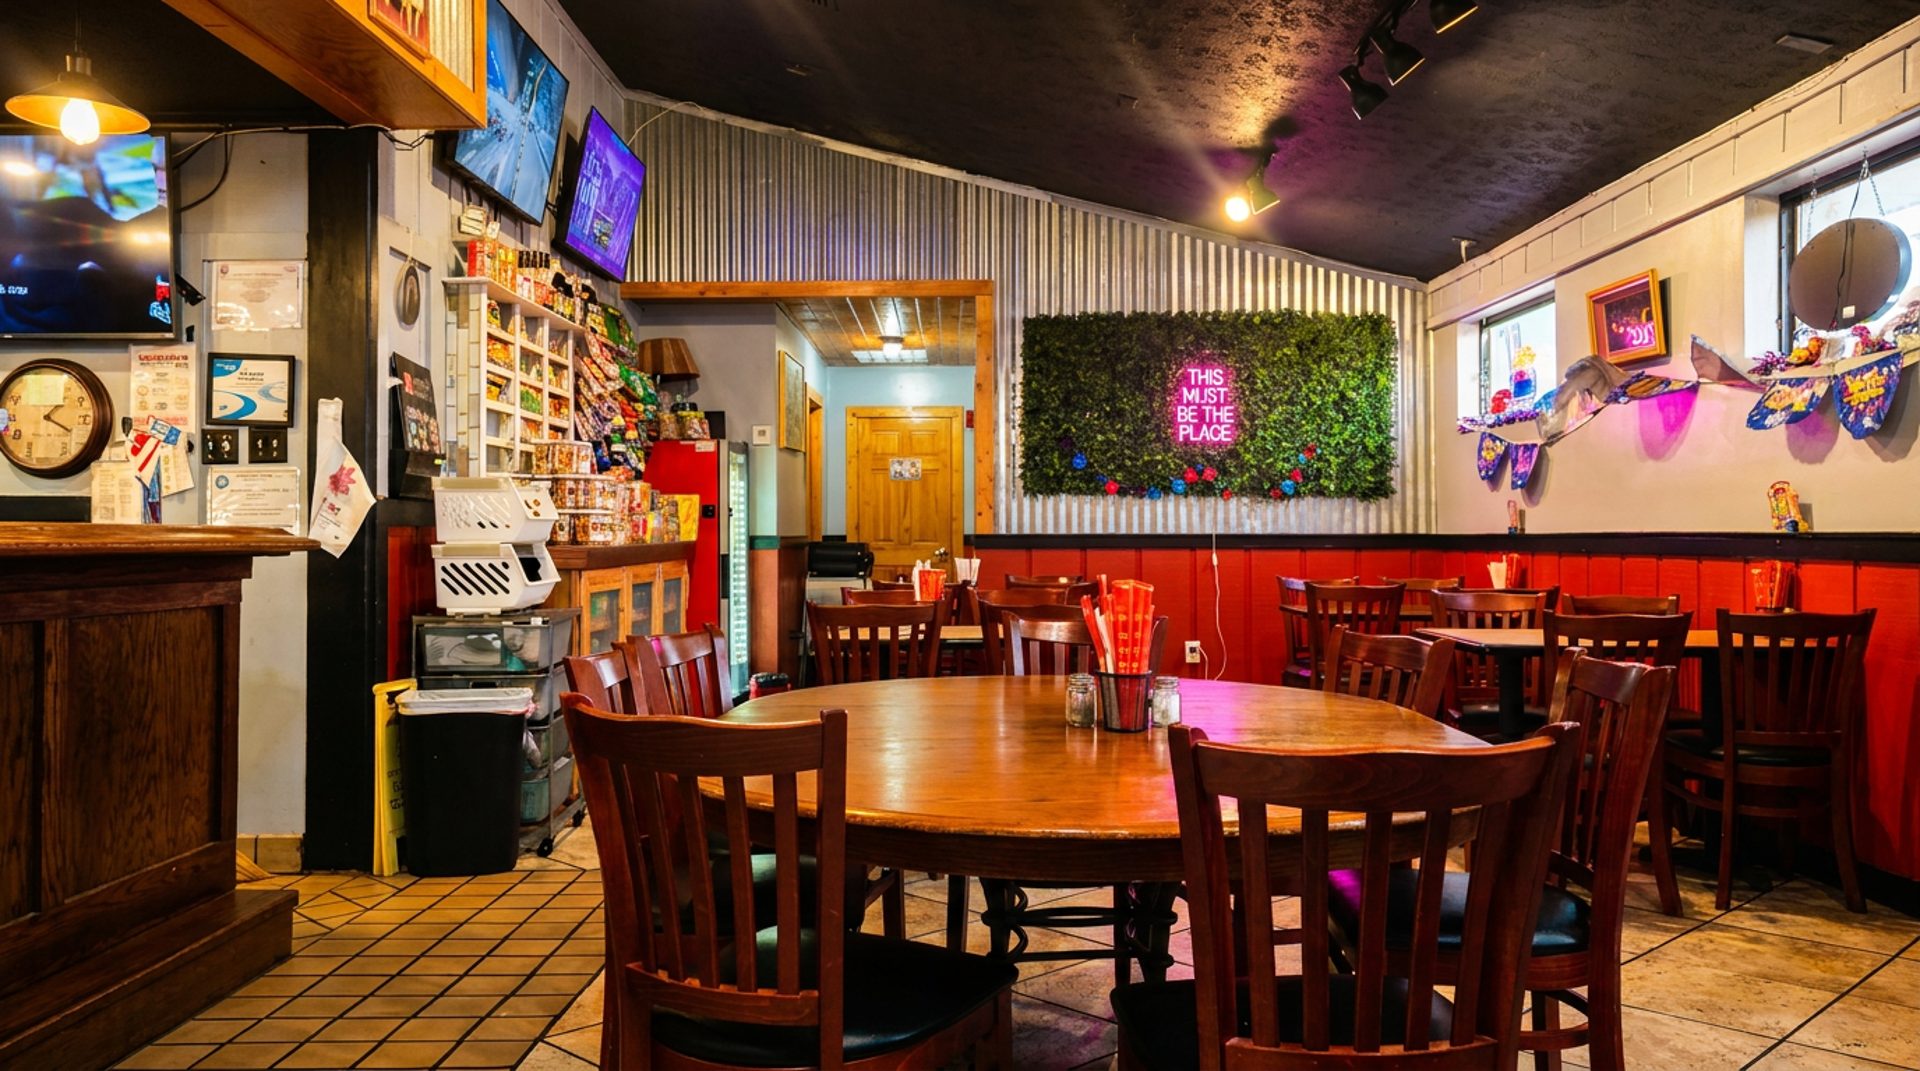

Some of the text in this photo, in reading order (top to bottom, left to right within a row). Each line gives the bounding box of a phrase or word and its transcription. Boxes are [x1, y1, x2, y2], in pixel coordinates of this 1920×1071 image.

[1187, 368, 1223, 385] THIS
[1182, 387, 1228, 403] MUST
[1177, 406, 1234, 423] BE THE
[1179, 424, 1232, 441] PLACE
